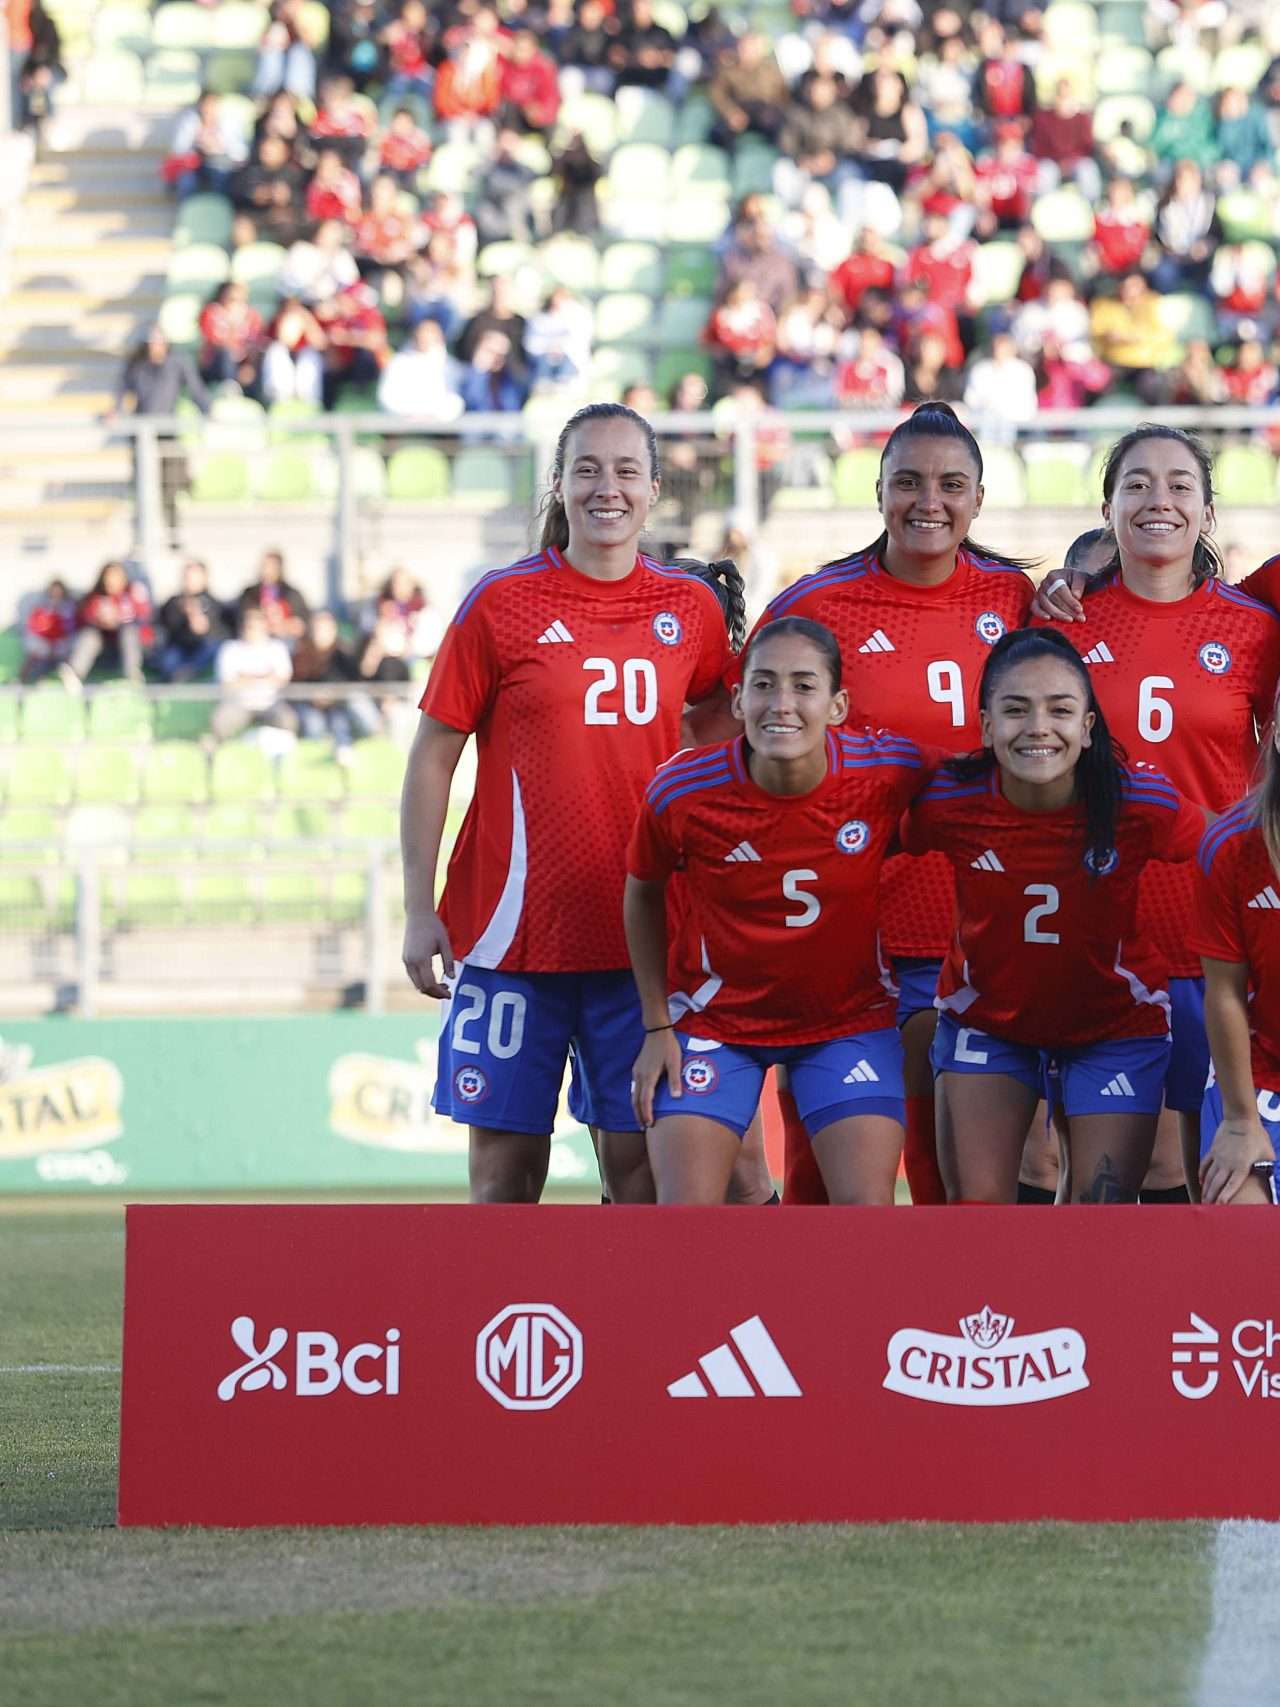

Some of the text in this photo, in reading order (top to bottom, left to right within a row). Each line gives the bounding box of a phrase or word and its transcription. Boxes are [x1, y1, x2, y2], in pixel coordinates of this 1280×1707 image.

[582, 657, 658, 726] 20
[926, 660, 966, 727] 9
[1137, 675, 1175, 743] 6
[782, 868, 821, 928] 5
[1023, 883, 1060, 945] 2
[451, 984, 527, 1060] 20
[296, 1328, 400, 1396] Bci
[489, 1316, 571, 1398] MG
[900, 1346, 1072, 1389] CRISTAL
